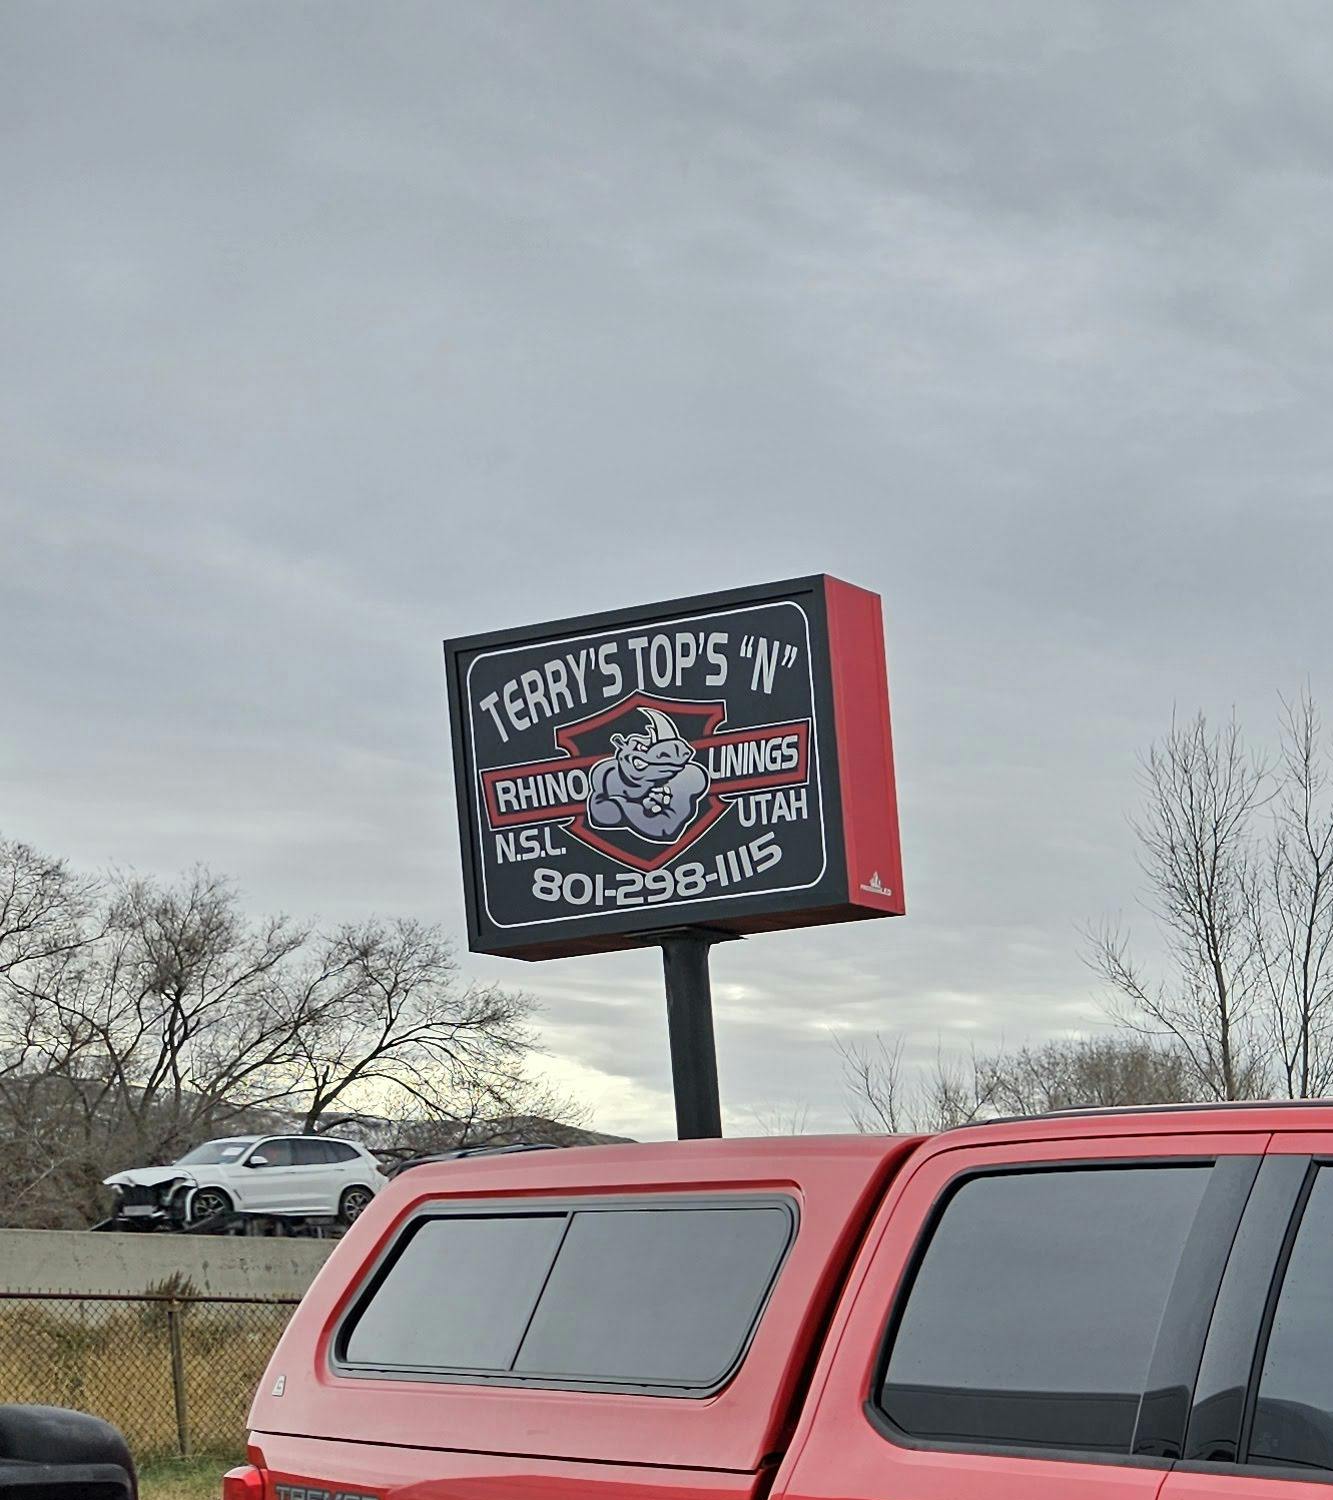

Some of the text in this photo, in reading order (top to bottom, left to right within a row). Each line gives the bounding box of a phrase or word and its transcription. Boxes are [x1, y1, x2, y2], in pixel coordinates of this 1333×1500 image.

[479, 641, 623, 743] TERRY'S
[628, 632, 729, 691] TOP'S
[495, 735, 799, 813] RHINO LININGS
[495, 788, 808, 864] N.S.L. UTAH
[532, 831, 783, 906] 801-298-1115
